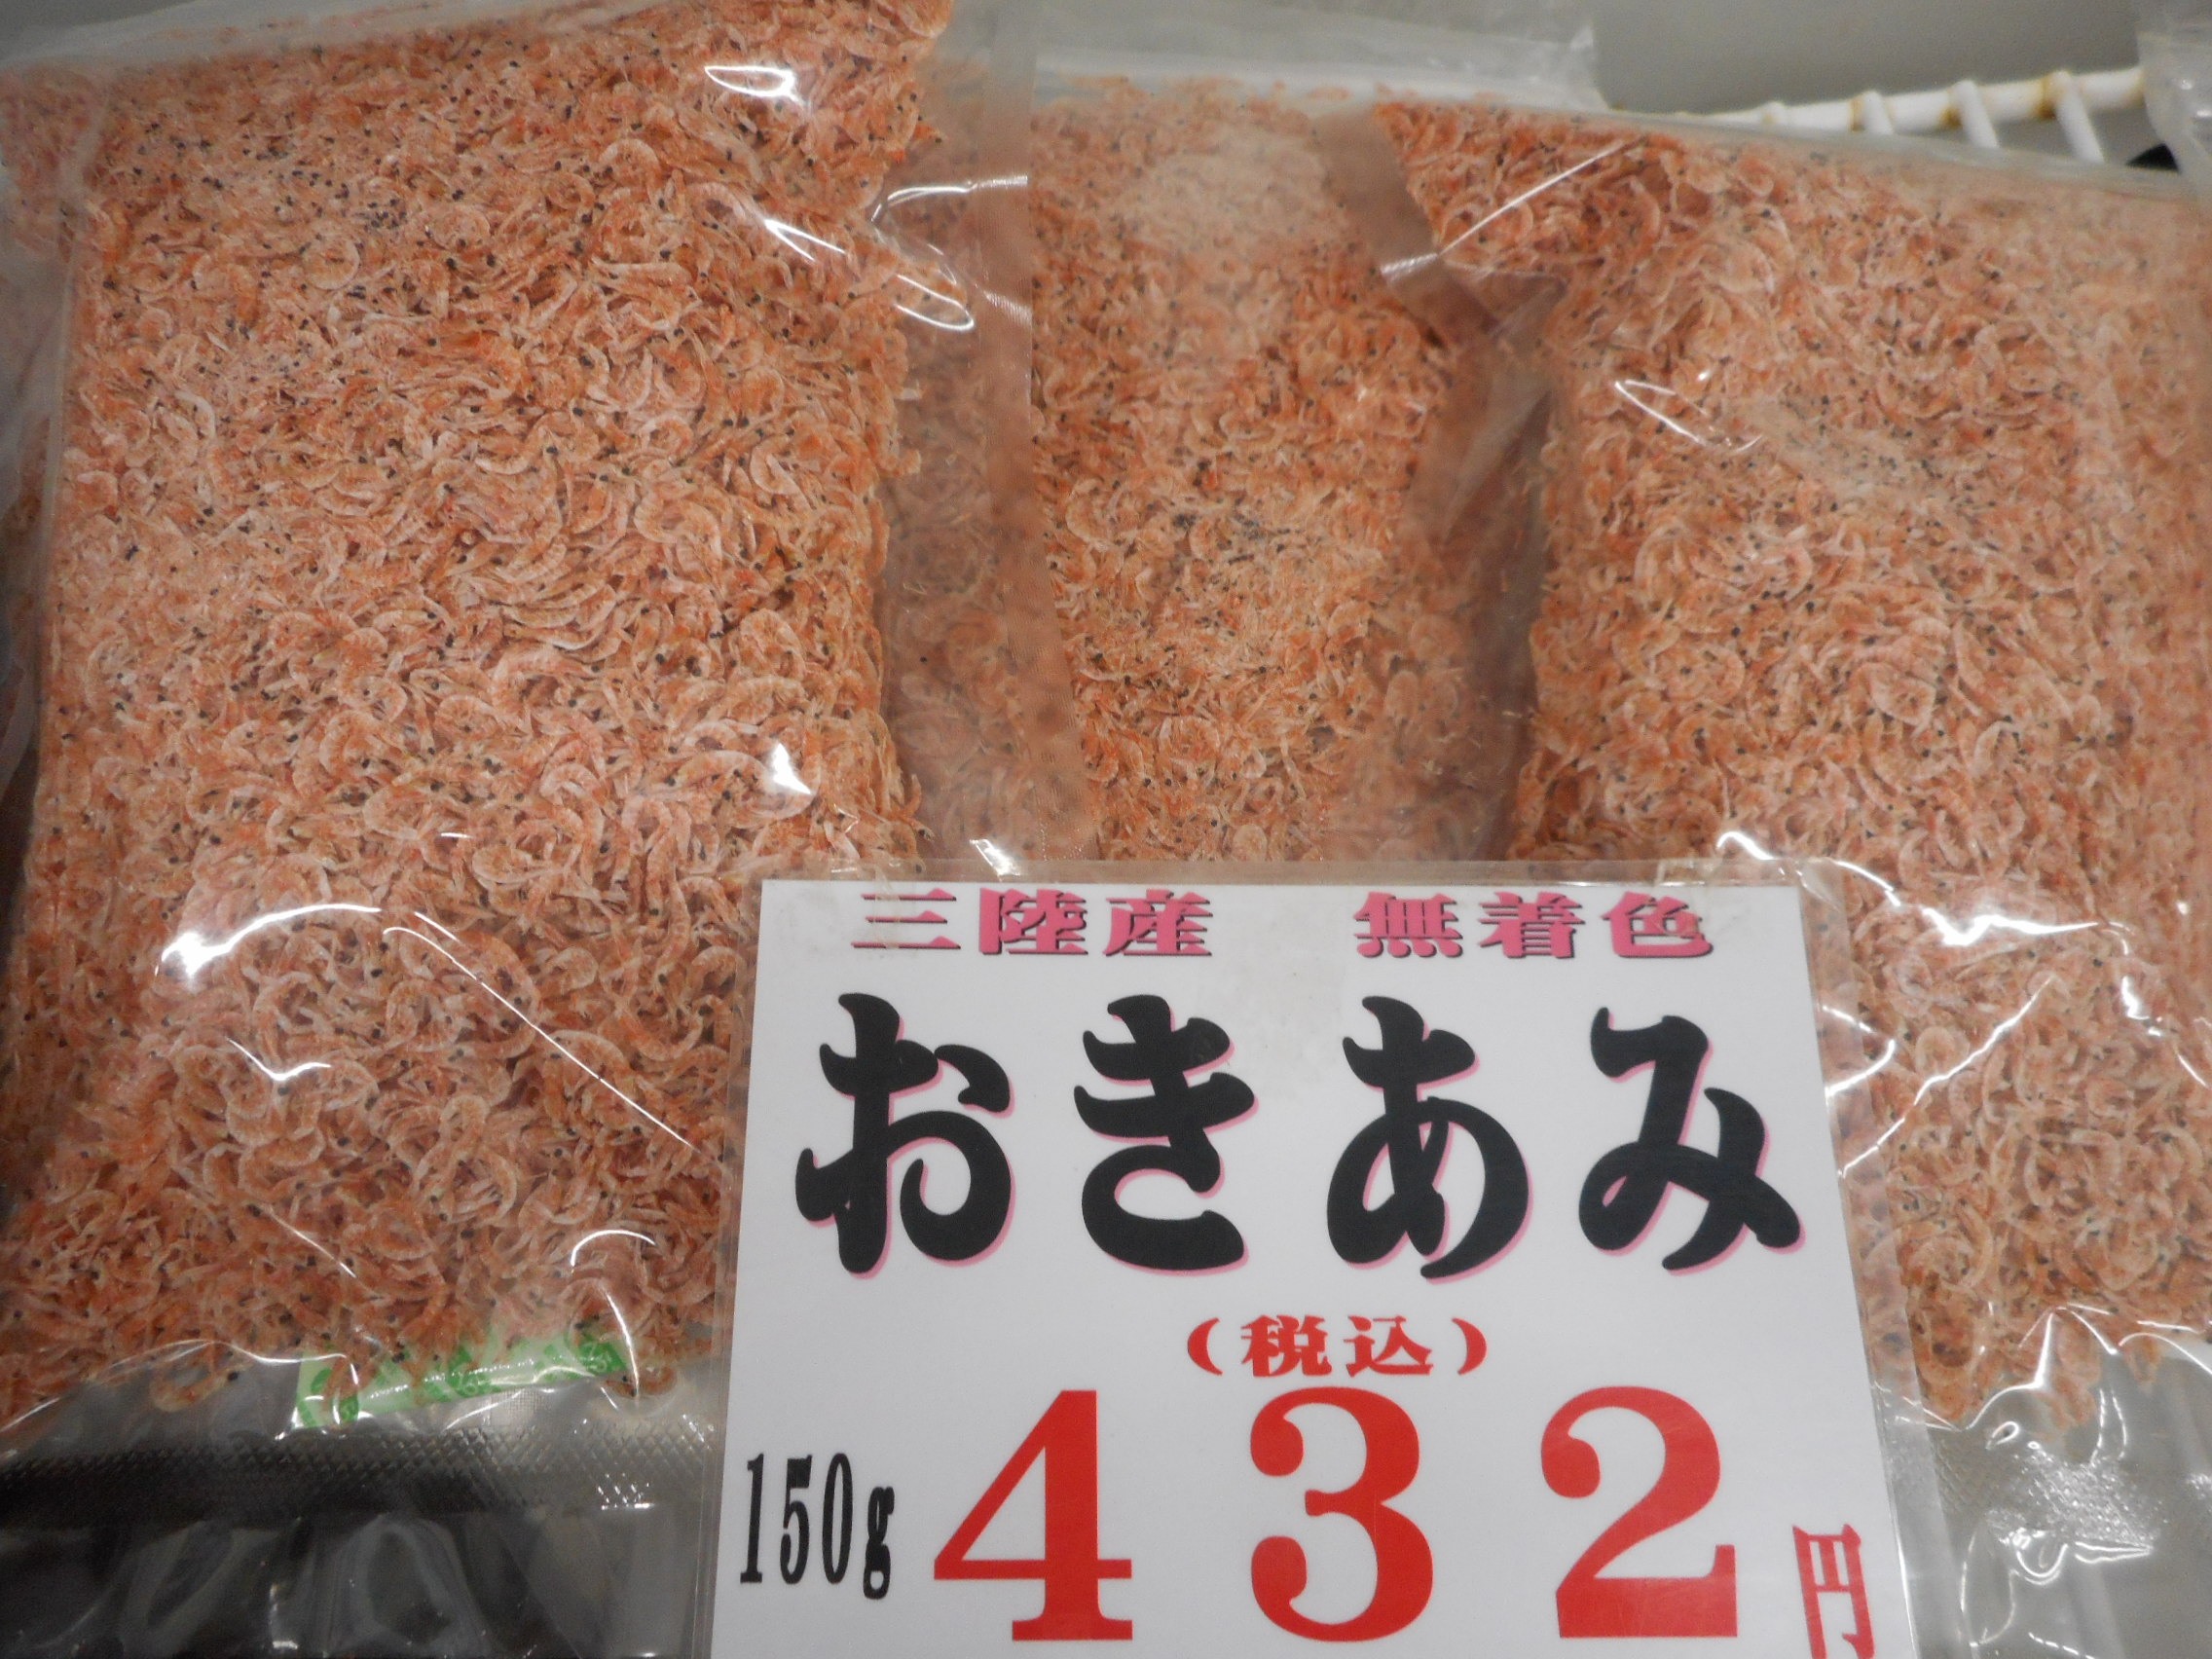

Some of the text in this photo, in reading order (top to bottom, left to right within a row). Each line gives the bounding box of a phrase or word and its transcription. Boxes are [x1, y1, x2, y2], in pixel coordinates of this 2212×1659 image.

[851, 888, 1714, 959] 三陸産 無着色
[795, 992, 1804, 1280] おきあみ
[739, 1452, 896, 1602] 150g
